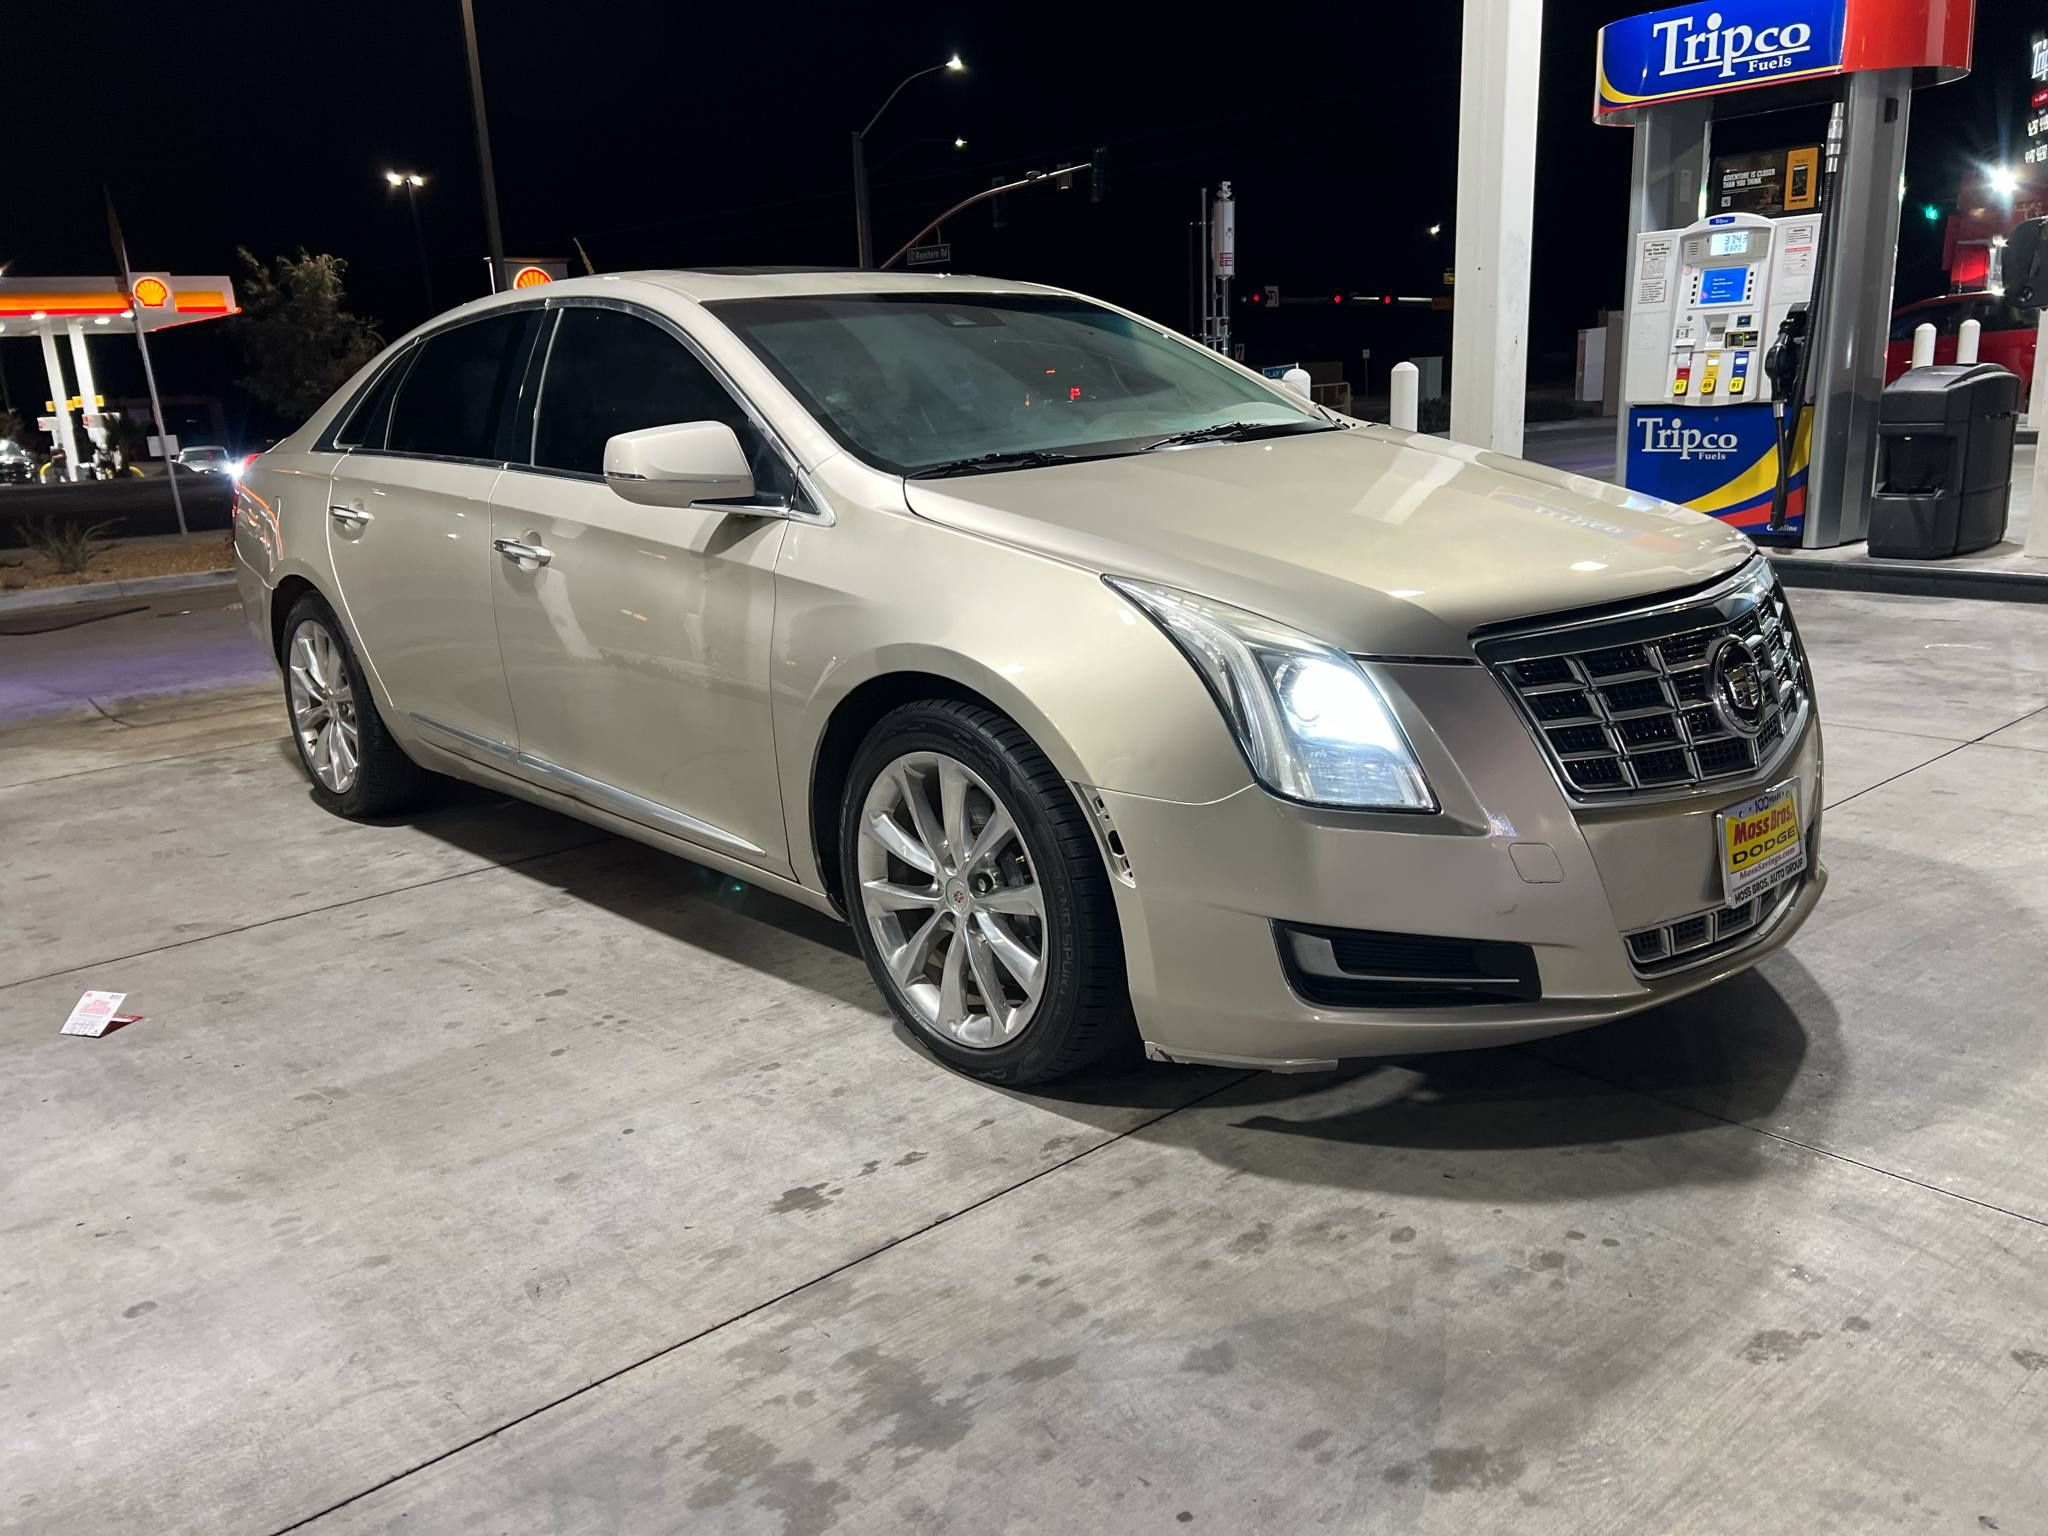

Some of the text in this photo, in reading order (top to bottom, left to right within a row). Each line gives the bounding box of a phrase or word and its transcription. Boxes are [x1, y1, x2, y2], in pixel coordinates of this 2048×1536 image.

[1652, 12, 1811, 78] Tripco
[1748, 55, 1792, 73] Fuels
[1736, 179, 1746, 187] YOU
[1747, 178, 1762, 186] THINK
[1637, 417, 1738, 460] Tripco
[1698, 452, 1726, 460] Fuels
[1754, 796, 1769, 813] 100
[1734, 804, 1793, 846] Moss Bros.
[1733, 826, 1796, 864] DODGE
[1734, 858, 1803, 905] MOSS BROS. AUTO GROUP
